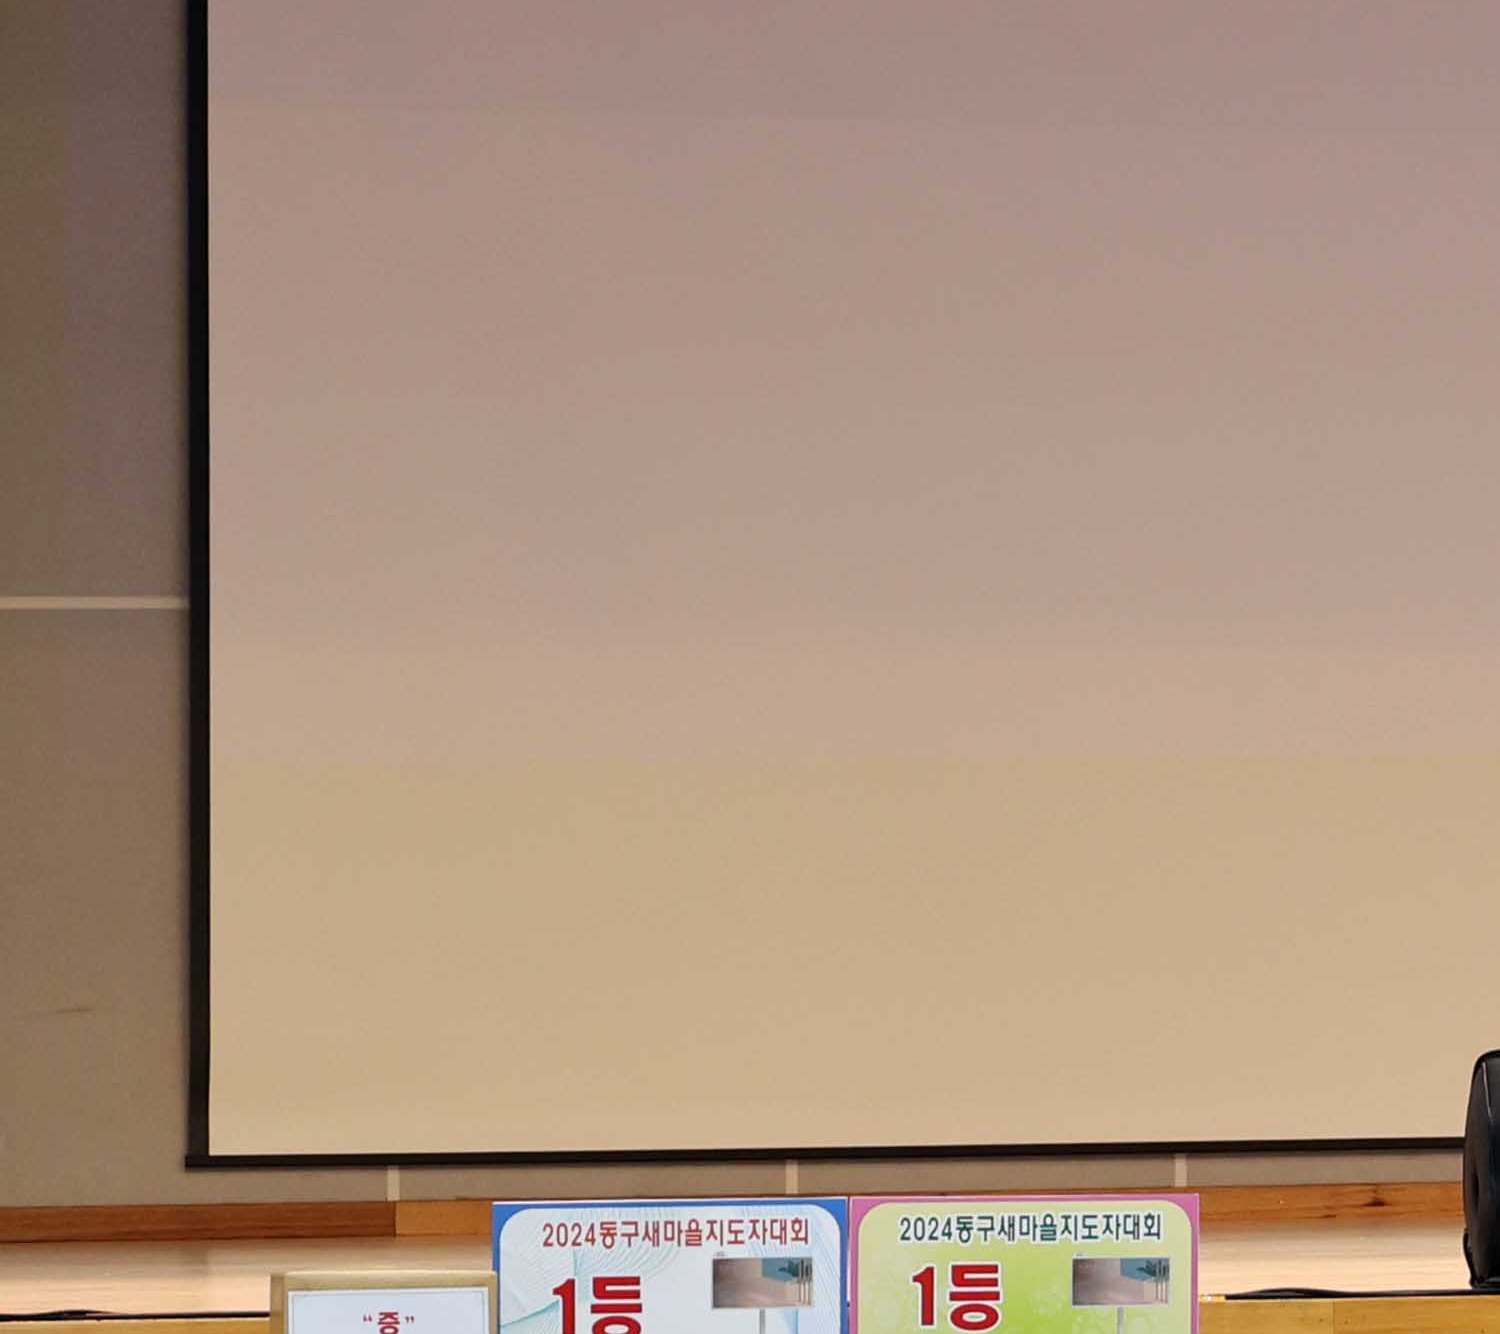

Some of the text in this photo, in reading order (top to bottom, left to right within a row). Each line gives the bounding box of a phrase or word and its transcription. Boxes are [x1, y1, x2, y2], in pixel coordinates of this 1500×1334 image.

[541, 1215, 810, 1249] 2024동구새마을지도자대회
[899, 1212, 1163, 1244] 2024동구새마을지도자대회
[911, 1263, 1002, 1332] 1등
